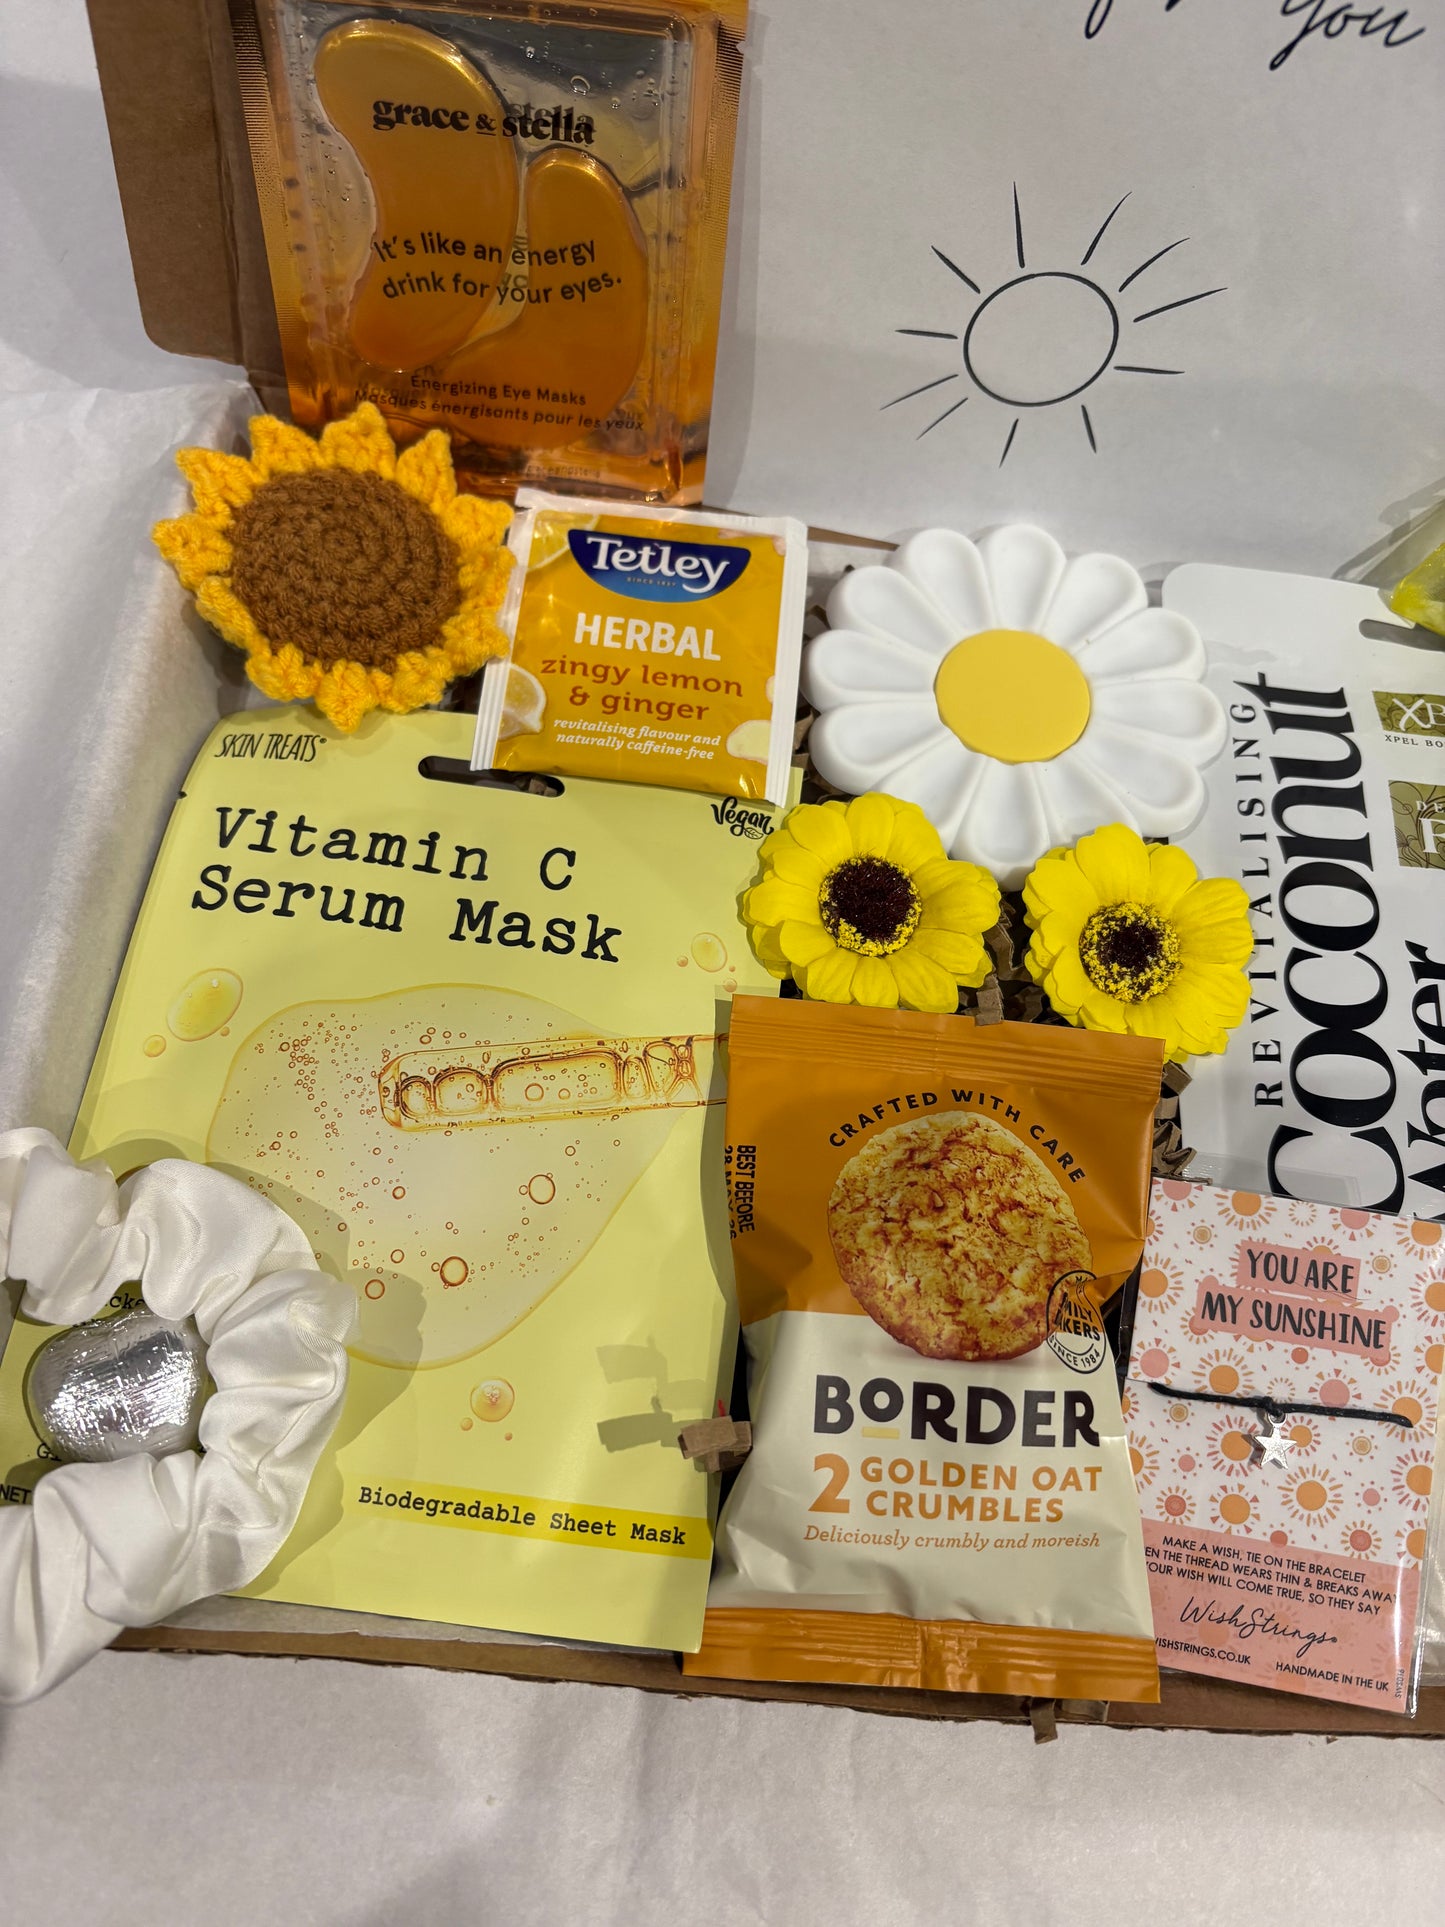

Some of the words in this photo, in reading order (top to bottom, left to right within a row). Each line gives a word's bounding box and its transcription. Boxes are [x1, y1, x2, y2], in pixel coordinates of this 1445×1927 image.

[373, 100, 469, 131] grace
[475, 113, 496, 136] &
[502, 112, 595, 145] stella
[374, 235, 416, 262] It's
[420, 232, 466, 256] like
[473, 244, 502, 263] an
[511, 240, 595, 266] energy
[383, 271, 446, 299] drink
[452, 273, 490, 298] for
[496, 286, 553, 305] your
[560, 272, 622, 302] eyes.
[355, 390, 427, 410] Masques
[432, 400, 528, 421] énergisants
[534, 411, 573, 425] pour
[578, 415, 601, 428] les
[605, 418, 645, 431] yeux
[411, 375, 497, 399] Energizing
[503, 385, 531, 401] Eye
[537, 388, 587, 406] Masks
[586, 536, 730, 594] Tetley
[574, 612, 721, 661] HERBAL
[541, 655, 631, 686] zingy
[641, 665, 743, 697] lemon
[569, 686, 590, 706] &
[601, 692, 710, 721] ginger
[214, 733, 261, 760] SKIN
[553, 718, 636, 738] revitalising
[637, 726, 691, 742] flavour
[693, 735, 721, 746] and
[556, 733, 624, 750] naturally
[627, 739, 714, 760] caffeine-free
[1384, 734, 1419, 746] XPEL
[1425, 739, 1445, 748] BO
[711, 796, 774, 836] Vegan
[216, 806, 489, 882] Vitamin
[539, 847, 577, 891] C
[191, 864, 406, 933] Serum
[448, 898, 623, 963] Mask
[1230, 702, 1283, 1108] REVITALISING
[1233, 671, 1404, 1216] Coconut
[829, 1092, 938, 1149] CRAFTED
[951, 1089, 1021, 1123] WITH
[1029, 1124, 1087, 1184] CARE
[735, 1145, 757, 1179] BEST
[734, 1181, 755, 1233] BEFORE
[1247, 1248, 1299, 1285] YOU
[1304, 1259, 1355, 1294] ARE
[1201, 1291, 1245, 1325] MY
[1249, 1299, 1387, 1350] SUNSHINE
[1081, 1348, 1101, 1368] 1984
[813, 1374, 1100, 1448] BORDER
[0, 1484, 32, 1504] NET
[807, 1453, 851, 1514] 2
[860, 1456, 1017, 1492] GOLDEN
[1031, 1466, 1103, 1492] OAT
[358, 1486, 536, 1526] Biodegradable
[550, 1513, 617, 1537] Sheet
[630, 1523, 687, 1546] Mask
[865, 1490, 1064, 1523] CRUMBLES
[804, 1524, 910, 1551] Deliciously
[914, 1530, 990, 1552] crumbly
[994, 1532, 1029, 1549] and
[1031, 1532, 1100, 1549] moreish
[1162, 1535, 1197, 1551] MAKE
[1199, 1543, 1209, 1553] A
[1212, 1545, 1242, 1561] WISH,
[1246, 1551, 1261, 1564] TIE
[1264, 1555, 1283, 1568] ON
[1286, 1558, 1306, 1572] THE
[1308, 1563, 1366, 1583] BRACELET
[1146, 1561, 1173, 1575] OUR
[1176, 1567, 1204, 1581] WISH
[1207, 1573, 1232, 1587] WILL
[1236, 1579, 1273, 1595] COME
[1276, 1586, 1305, 1602] TRUE,
[1308, 1592, 1325, 1605] SO
[1328, 1597, 1354, 1610] THEY
[1357, 1602, 1381, 1616] SAY
[1163, 1549, 1183, 1563] THE
[1185, 1554, 1229, 1571] THREAD
[1232, 1563, 1272, 1580] WEARS
[1275, 1571, 1300, 1586] THIN
[1303, 1577, 1312, 1588] &
[1316, 1579, 1359, 1597] BREAKS
[1155, 1637, 1251, 1665] ISHSTRINGS.CO.UK
[1275, 1661, 1339, 1683] HANDMADE
[1341, 1673, 1353, 1684] IN
[1355, 1676, 1374, 1689] THE
[1375, 1679, 1389, 1692] UK
